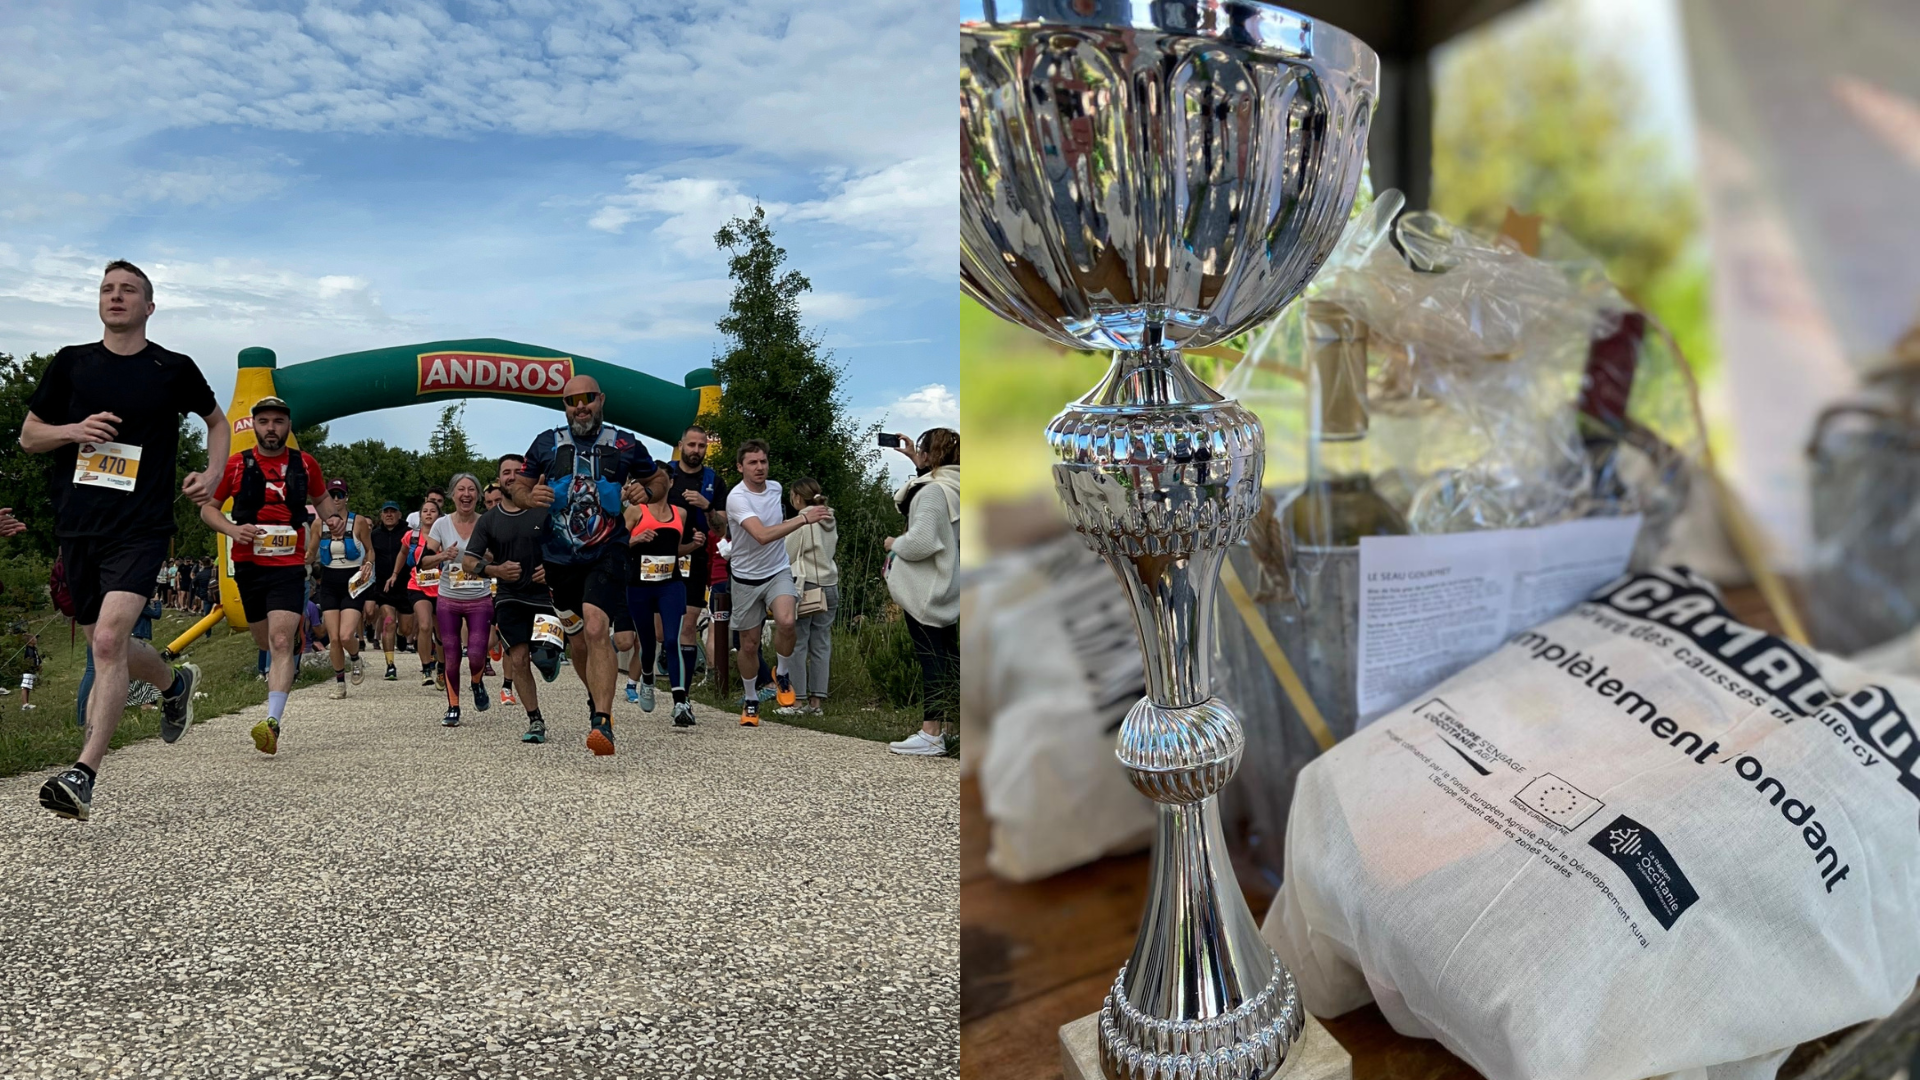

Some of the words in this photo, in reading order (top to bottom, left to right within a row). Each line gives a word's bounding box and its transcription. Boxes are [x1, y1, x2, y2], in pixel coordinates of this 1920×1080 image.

[424, 359, 566, 391] ANDROS
[98, 455, 126, 475] 470
[271, 535, 290, 547] 491
[654, 563, 669, 573] 346
[1367, 572, 1378, 582] LE
[1380, 570, 1406, 582] SEAU
[1408, 566, 1452, 580] GOURMET
[547, 623, 563, 638] 347
[1629, 624, 1674, 648] des
[1673, 647, 1766, 706] causses
[1424, 712, 1477, 750] L'OCCITANIE
[1474, 748, 1499, 764] AGIT
[1438, 711, 1481, 742] L'EUROPE
[1479, 738, 1527, 774] S'ENGAGE
[1508, 797, 1527, 813] UNION
[1428, 773, 1458, 797] L'Europe
[1456, 796, 1485, 817] investit
[1483, 814, 1502, 830] dans
[1502, 827, 1516, 839] les
[1514, 836, 1542, 855] zones
[1541, 853, 1573, 879] rurales
[1719, 750, 1850, 894] ondant
[1401, 741, 1431, 764] cofinancé
[1428, 761, 1443, 772] par
[1441, 770, 1450, 779] le
[1449, 776, 1471, 795] Fonds
[1470, 792, 1505, 819] Européen
[1504, 815, 1537, 840] Agricole
[1535, 837, 1559, 854] pour
[1558, 850, 1569, 861] le
[1568, 857, 1630, 923] Développement
[1629, 922, 1650, 949] Rural
[1647, 851, 1656, 860] La
[1653, 858, 1671, 882] Région
[1641, 856, 1679, 912] Occitanie
